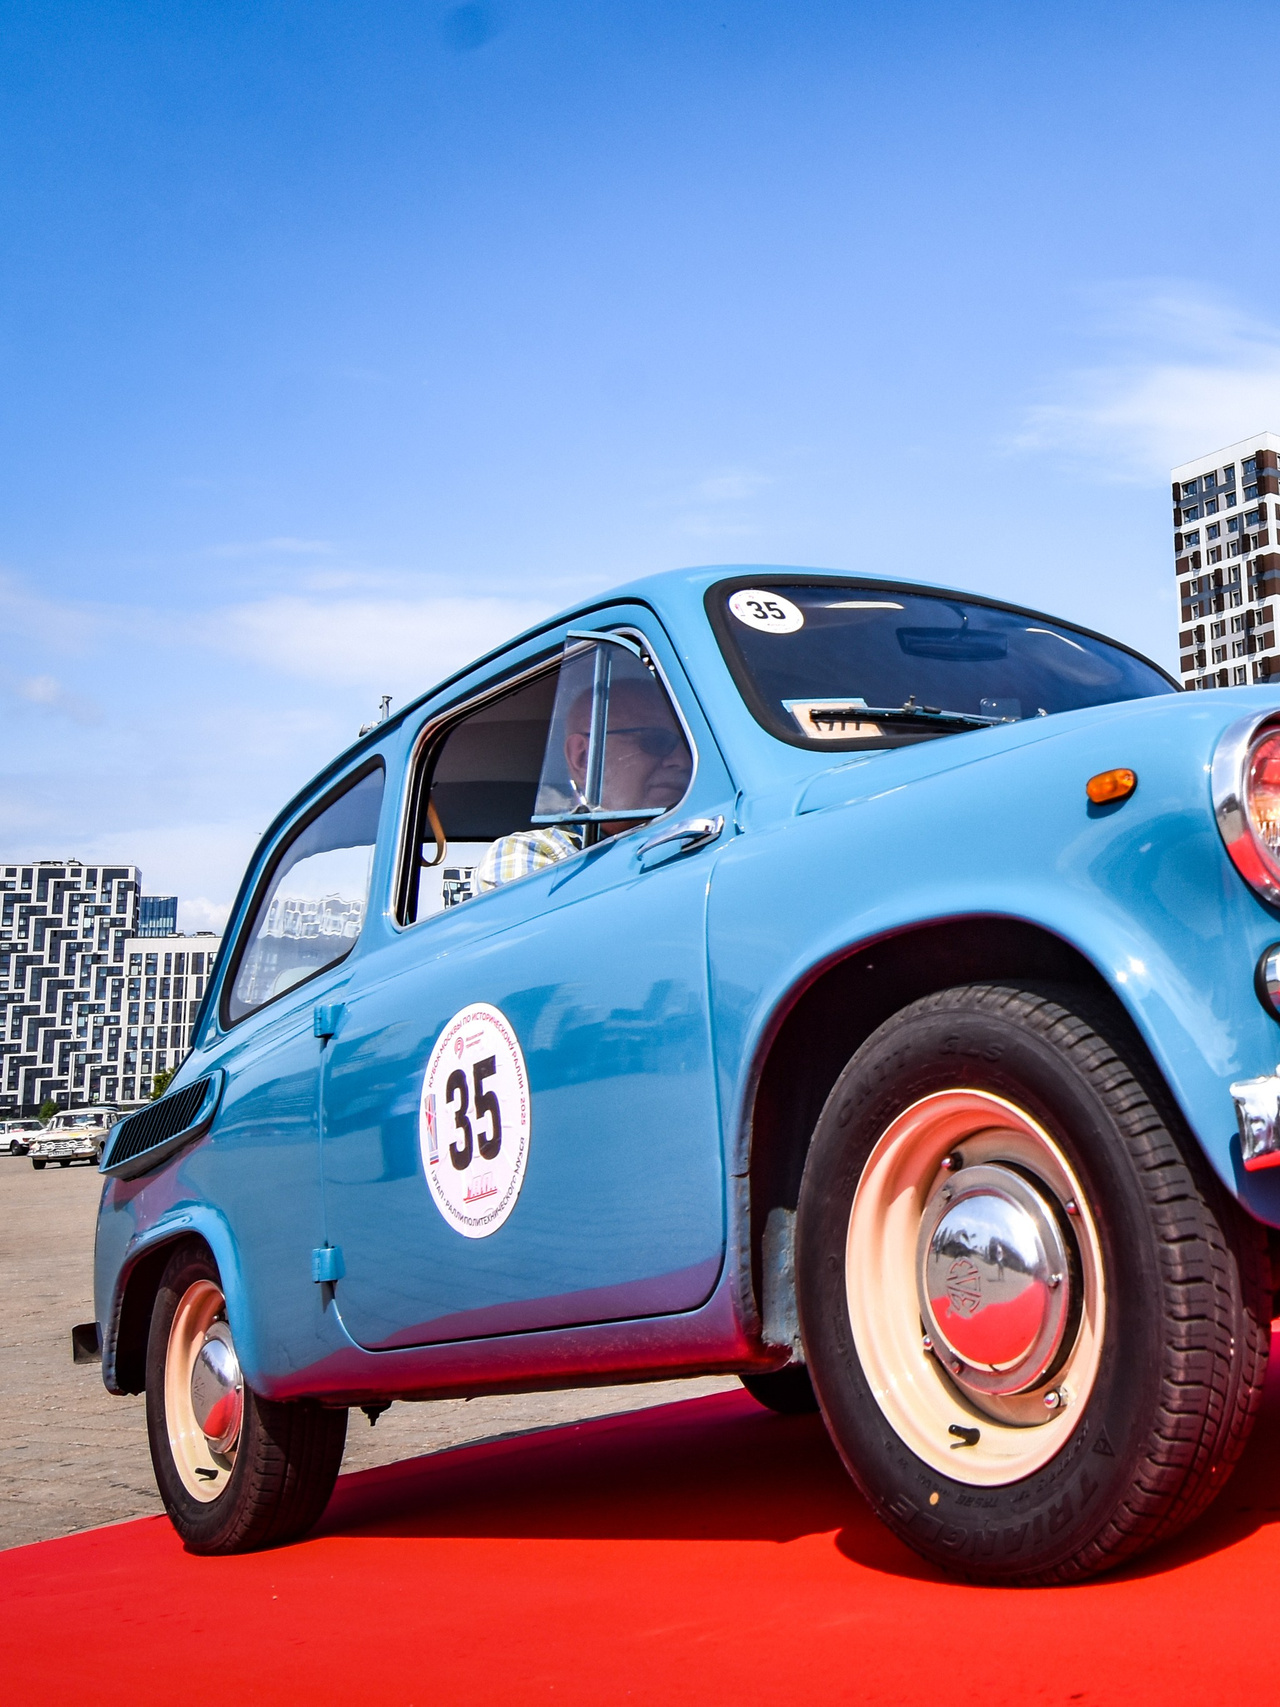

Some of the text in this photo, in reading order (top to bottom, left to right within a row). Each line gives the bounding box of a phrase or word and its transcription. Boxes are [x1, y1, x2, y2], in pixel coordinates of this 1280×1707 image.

[746, 601, 786, 619] 35
[428, 1053, 441, 1088] КУБОК
[439, 1020, 462, 1054] МОСКВЫ
[511, 1051, 524, 1089] РАЛЛИ
[445, 1055, 502, 1171] 35
[889, 1469, 1099, 1556] TRIANGLE
